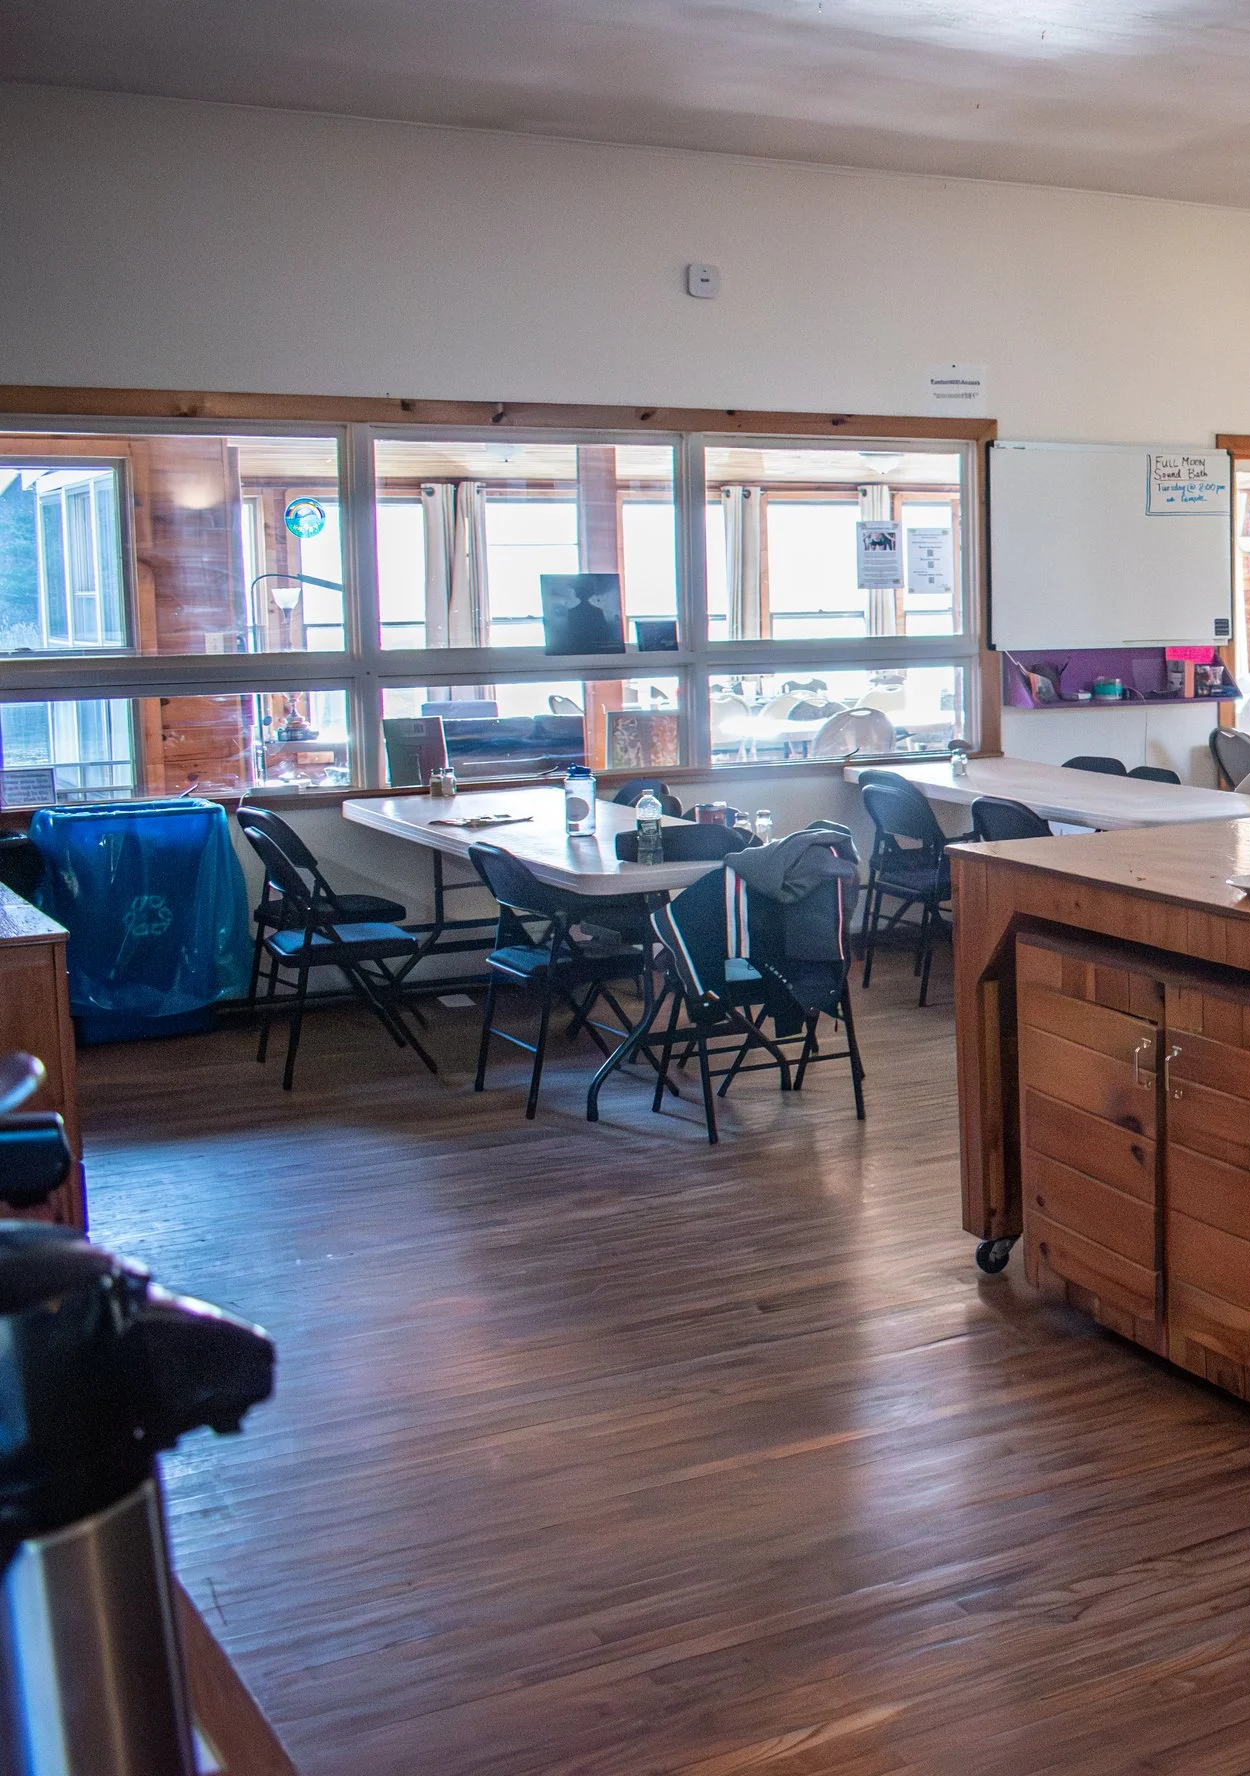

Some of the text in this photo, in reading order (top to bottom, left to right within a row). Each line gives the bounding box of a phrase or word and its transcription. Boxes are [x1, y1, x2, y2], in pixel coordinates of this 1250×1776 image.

[1155, 456, 1178, 468] FULL
[1154, 468, 1208, 480] Sound Bath
[1157, 483, 1186, 495] Tuesday
